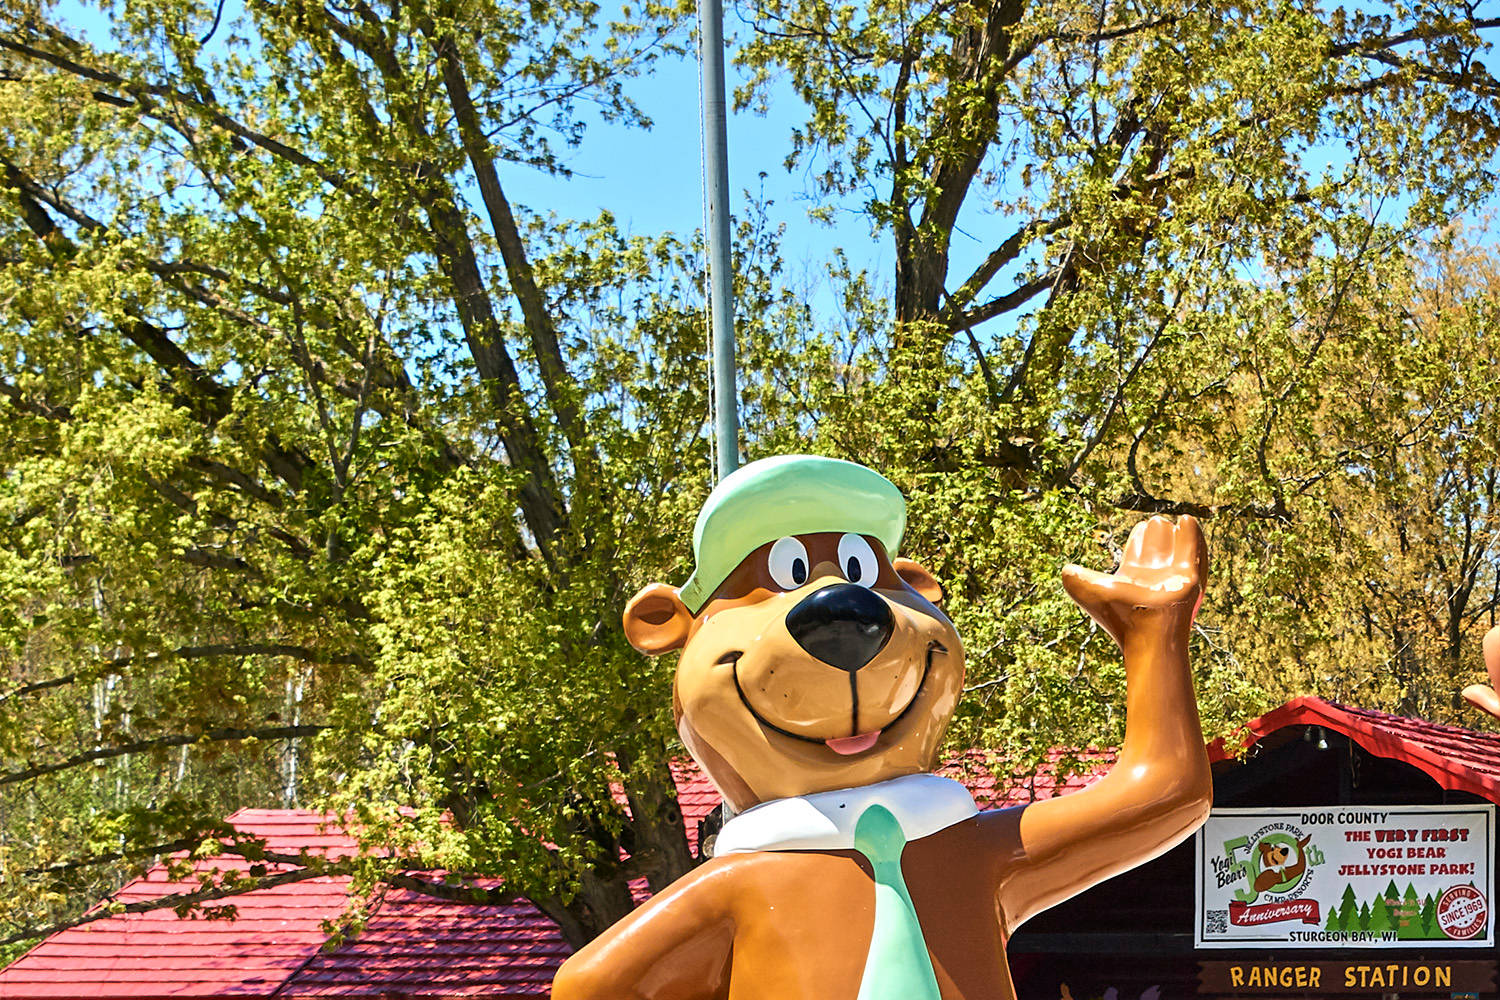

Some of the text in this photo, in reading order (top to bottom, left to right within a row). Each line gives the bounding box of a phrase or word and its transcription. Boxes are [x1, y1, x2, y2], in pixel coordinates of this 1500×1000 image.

[1301, 812, 1388, 825] DOOR COUNTY
[1285, 823, 1304, 840] PARK
[1344, 828, 1470, 842] THE VERY FIRST
[1366, 847, 1446, 859] YOGI BEAR
[1211, 852, 1234, 874] Yogi
[1338, 863, 1475, 876] JELLYSTONE PARK!
[1216, 864, 1247, 889] Bear's
[1442, 888, 1471, 907] SERVING
[1237, 903, 1313, 923] Anniversary
[1441, 909, 1465, 926] SINCE
[1465, 899, 1483, 914] 1969
[1453, 918, 1483, 936] FAMILIES
[1289, 931, 1348, 942] STURGEON
[1351, 931, 1377, 944] BAY,
[1230, 964, 1451, 988] RANGER STATION
